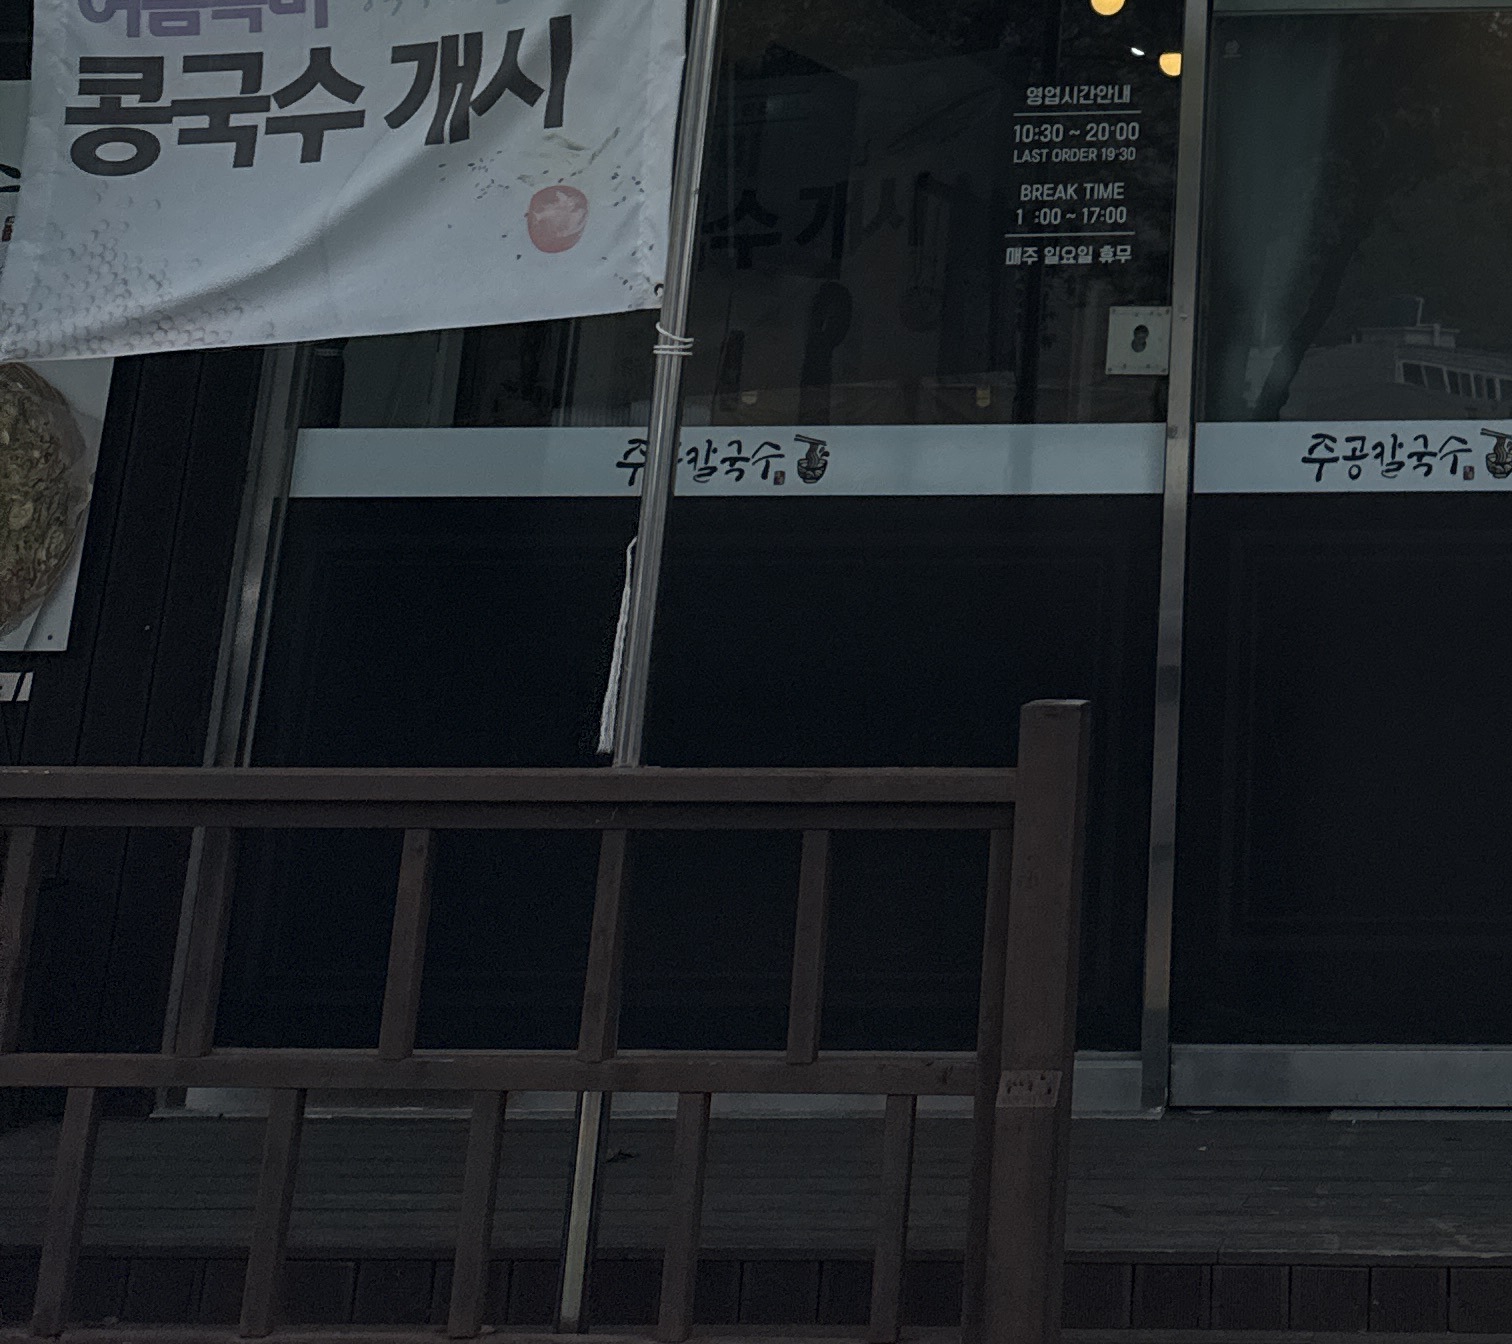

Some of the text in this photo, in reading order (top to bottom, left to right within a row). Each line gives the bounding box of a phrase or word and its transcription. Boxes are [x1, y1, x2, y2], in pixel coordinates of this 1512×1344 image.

[64, 14, 573, 177] 콩국수 개시
[1026, 84, 1131, 106] 영업시간안내
[1013, 124, 1064, 143] 10:30
[1013, 149, 1049, 163] LAST
[1051, 147, 1098, 162] ORDER
[1020, 182, 1125, 201] BREAK TIME
[1082, 206, 1127, 224] 17:00
[1005, 245, 1132, 265] 매주 일요일 휴무
[616, 438, 785, 487] 주칼국수
[1301, 432, 1473, 483] 주공칼국수
